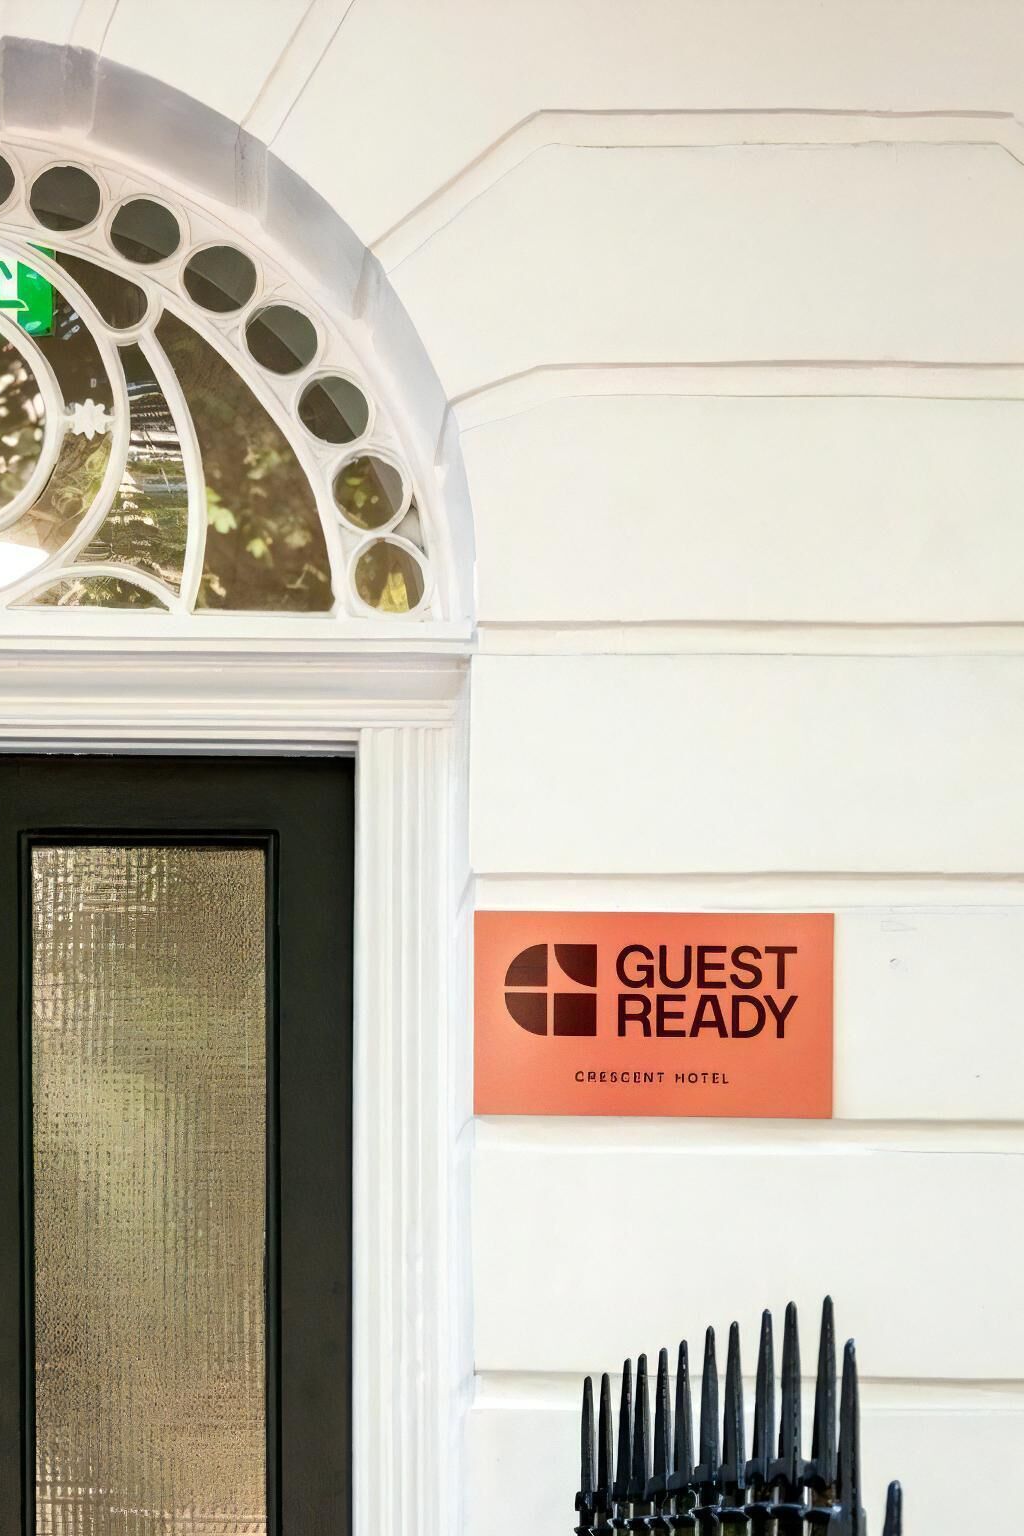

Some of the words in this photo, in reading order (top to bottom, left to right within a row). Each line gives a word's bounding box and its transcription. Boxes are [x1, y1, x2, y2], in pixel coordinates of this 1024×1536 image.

[615, 944, 798, 990] GUEST
[617, 993, 799, 1039] READY
[574, 1070, 665, 1084] CRESCENT
[674, 1072, 729, 1085] HOTEL
